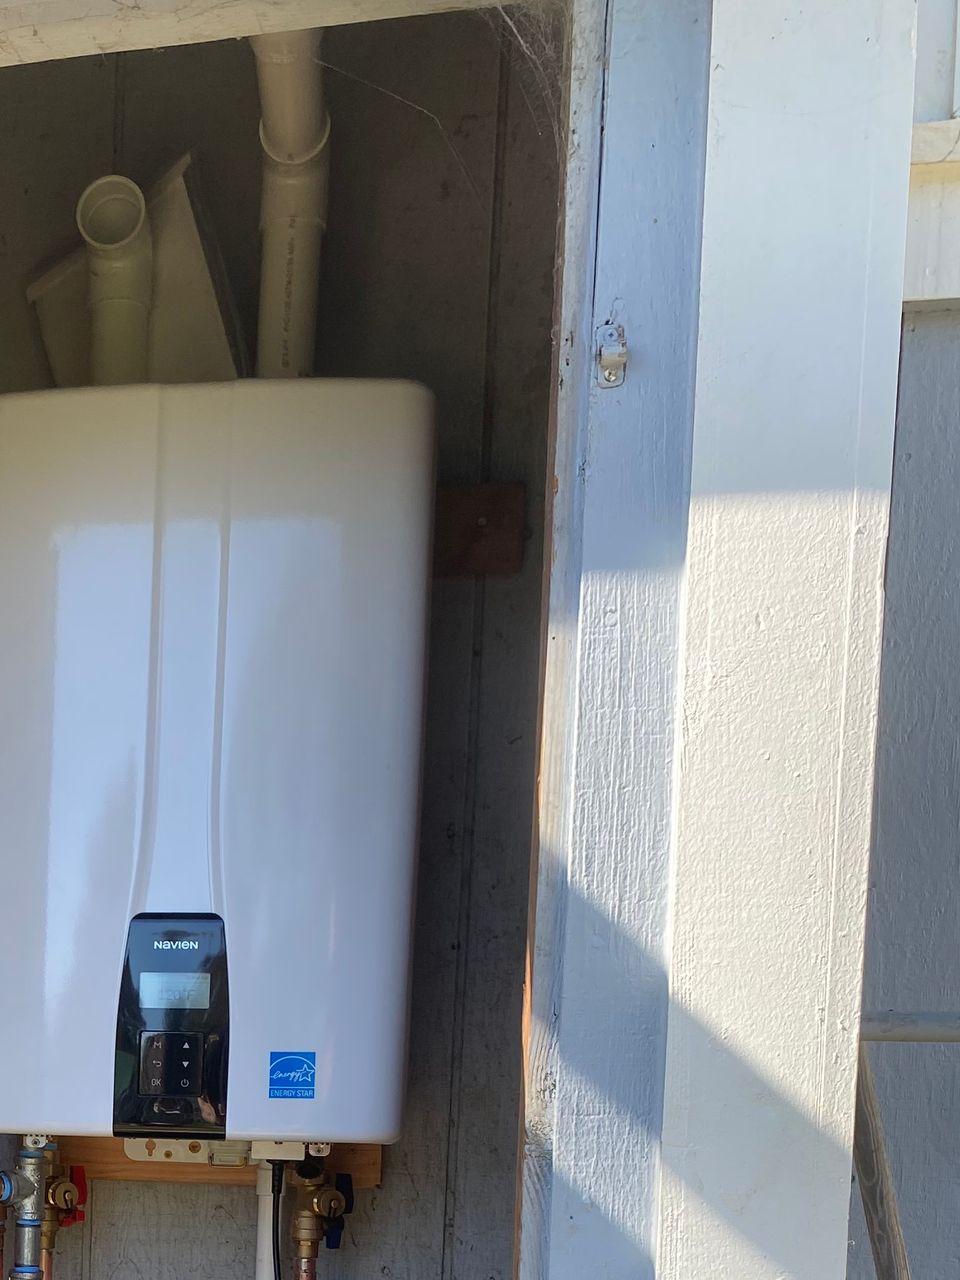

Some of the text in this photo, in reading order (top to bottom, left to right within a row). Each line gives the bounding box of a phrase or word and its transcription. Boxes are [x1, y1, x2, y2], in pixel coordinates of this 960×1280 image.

[153, 1041, 162, 1049] M
[151, 1078, 162, 1087] OK
[270, 1089, 314, 1097] ENERGY STAR
